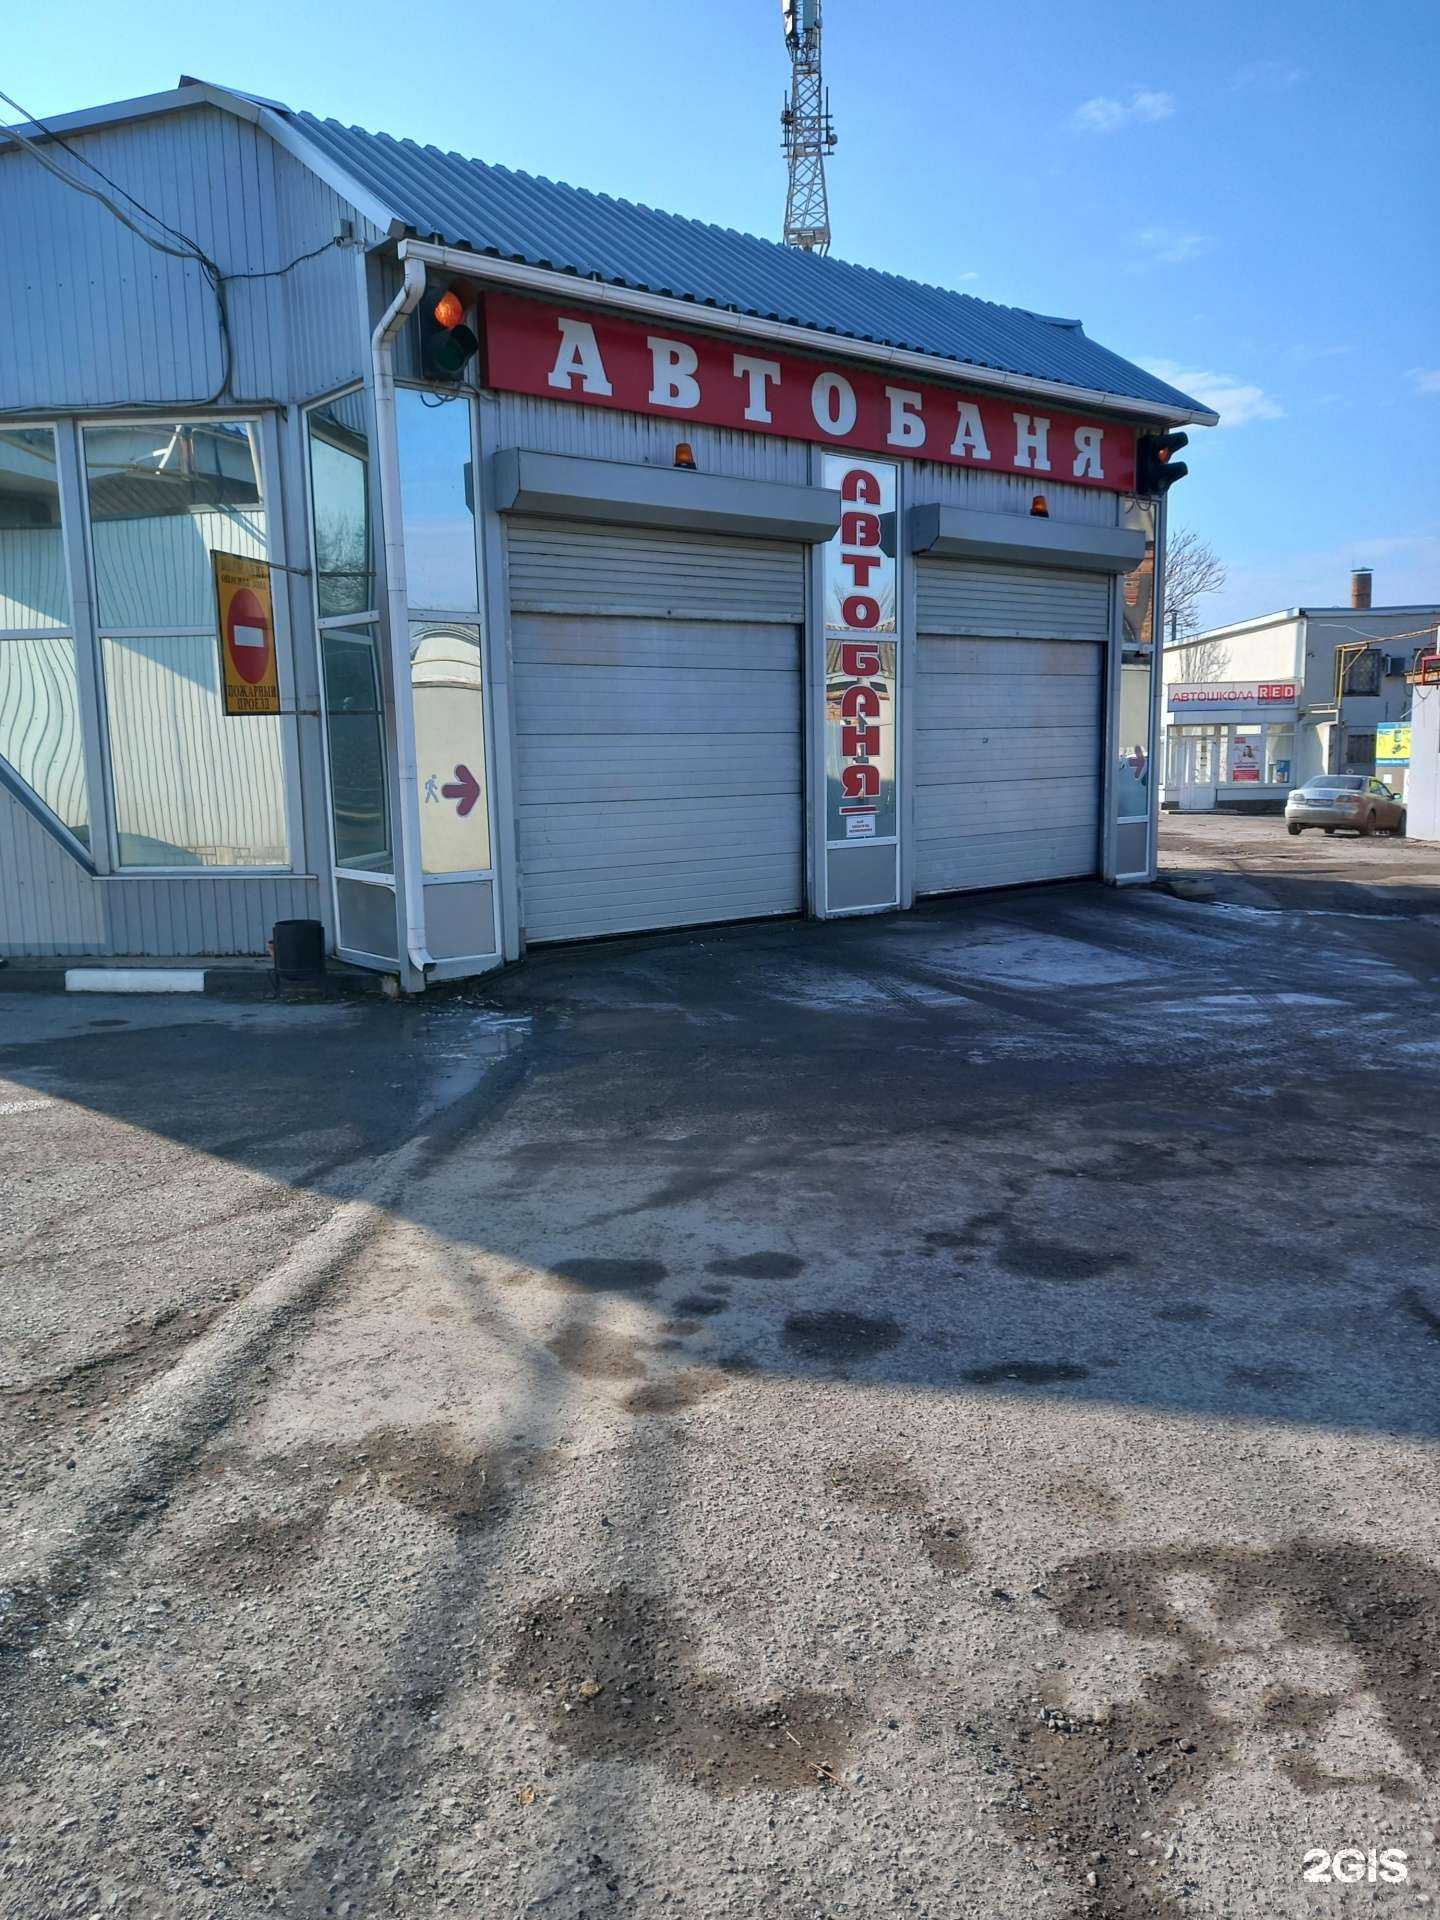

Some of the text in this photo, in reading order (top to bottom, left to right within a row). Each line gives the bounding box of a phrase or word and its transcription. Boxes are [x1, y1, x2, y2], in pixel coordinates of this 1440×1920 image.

[548, 317, 1104, 479] АВТОБАНЯ
[840, 469, 882, 799] АВТОБАНЯ
[1172, 686, 1294, 702] АВТОШКОЛА RED
